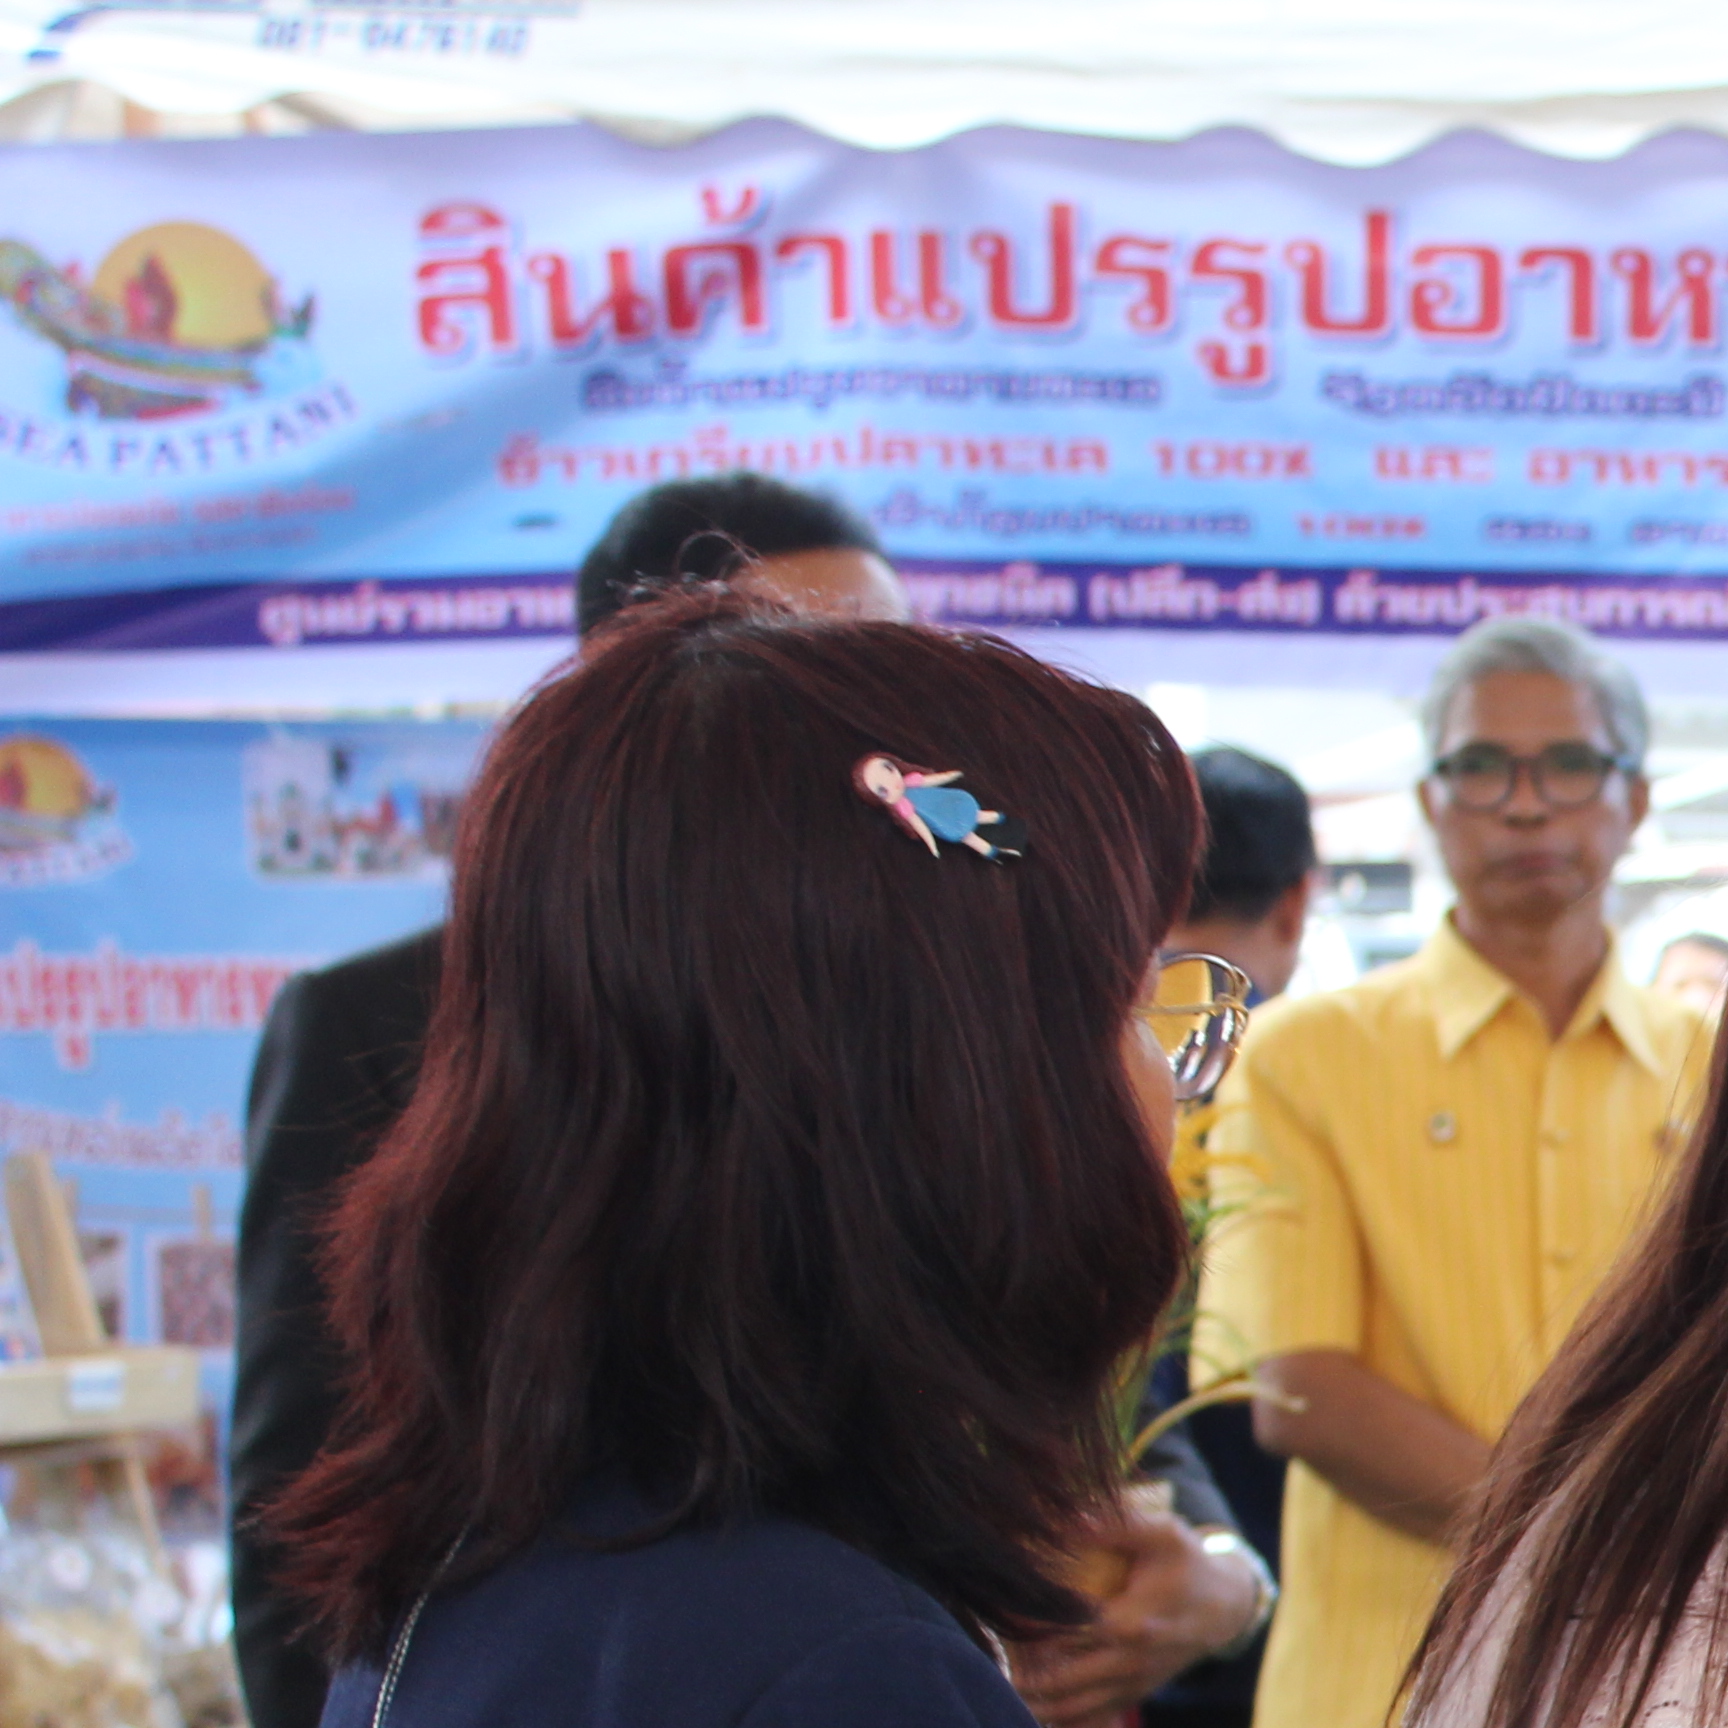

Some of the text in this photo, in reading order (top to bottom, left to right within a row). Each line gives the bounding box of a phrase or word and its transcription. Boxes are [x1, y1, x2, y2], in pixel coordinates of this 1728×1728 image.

[108, 384, 357, 475] PATTANI
[258, 580, 580, 645] ศูนย์รวมอาห
